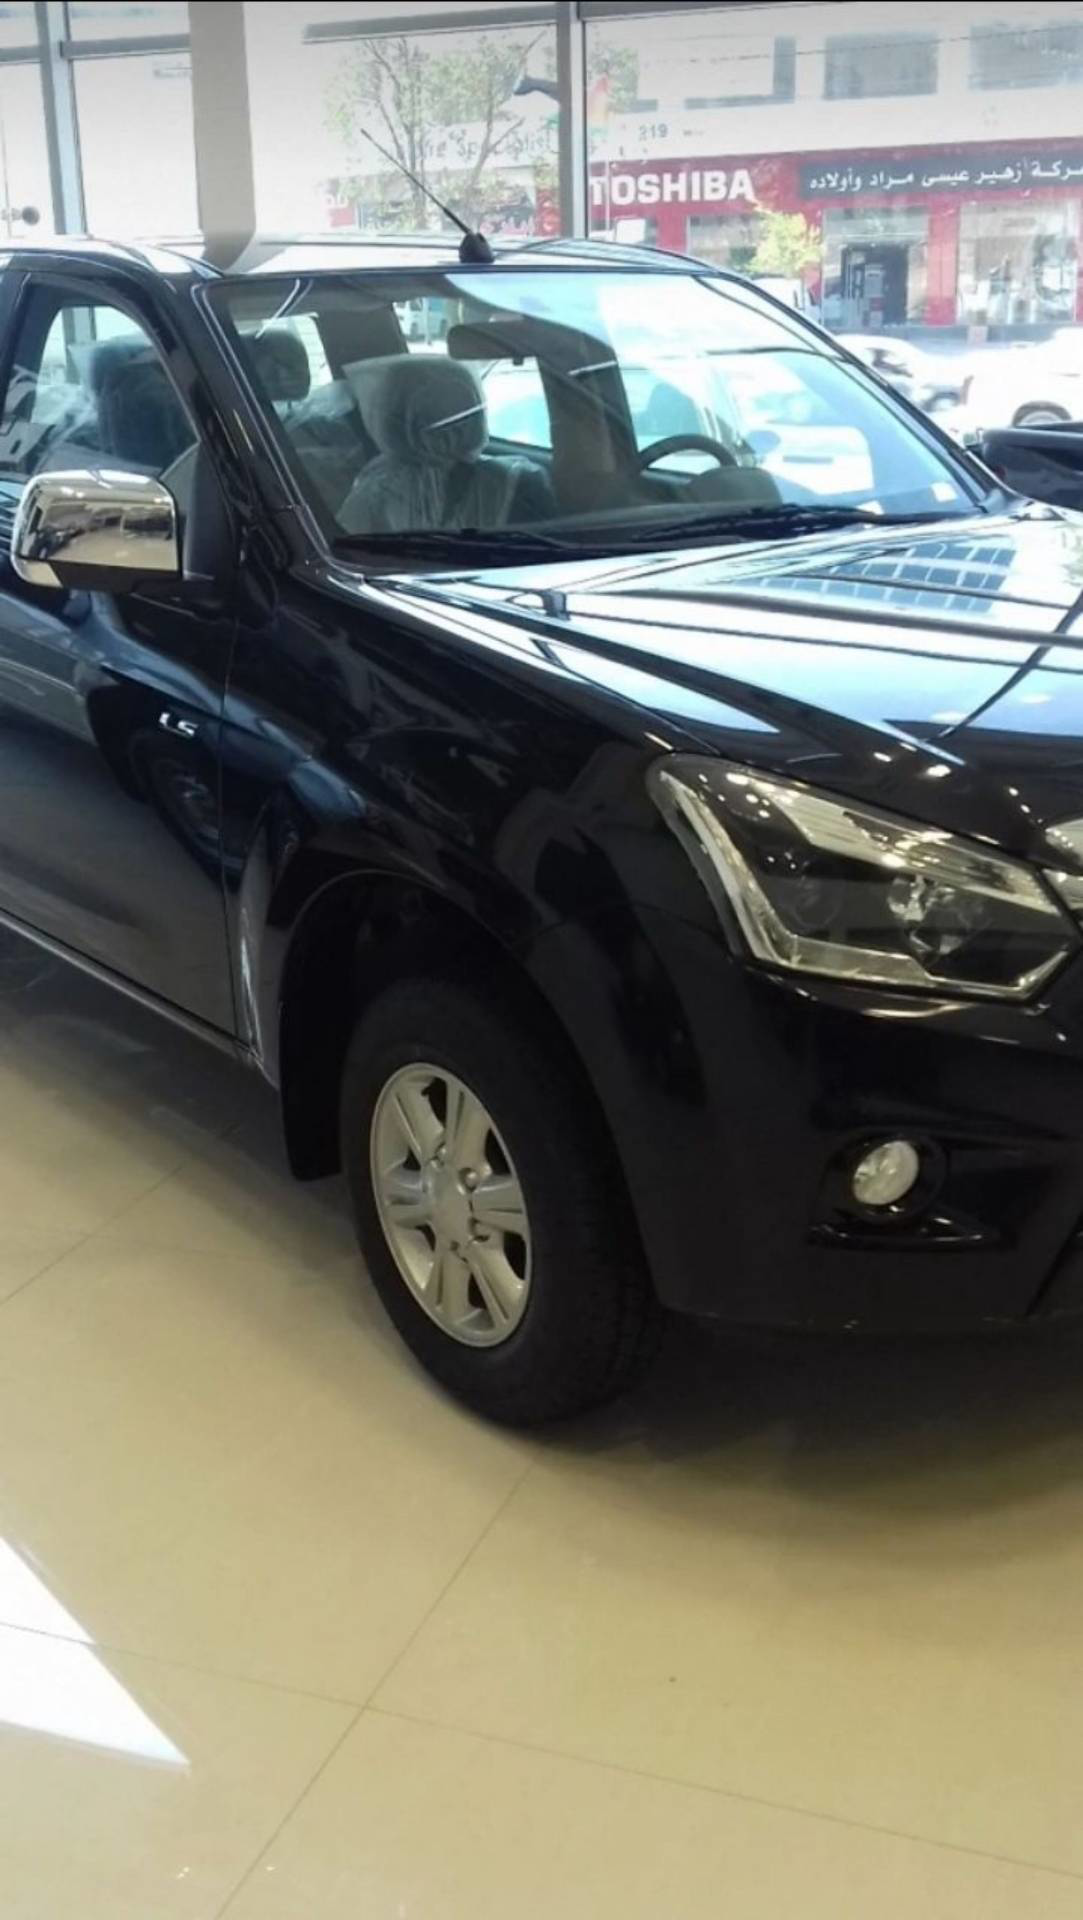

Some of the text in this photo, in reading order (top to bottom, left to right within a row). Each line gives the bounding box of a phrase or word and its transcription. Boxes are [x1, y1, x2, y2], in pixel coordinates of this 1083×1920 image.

[809, 166, 862, 193] وأولاده
[869, 170, 914, 190] مراد
[920, 169, 970, 188] عيسى
[1031, 159, 1083, 182] ركة
[588, 168, 757, 206] TOSHIBA
[158, 711, 199, 739] LS
